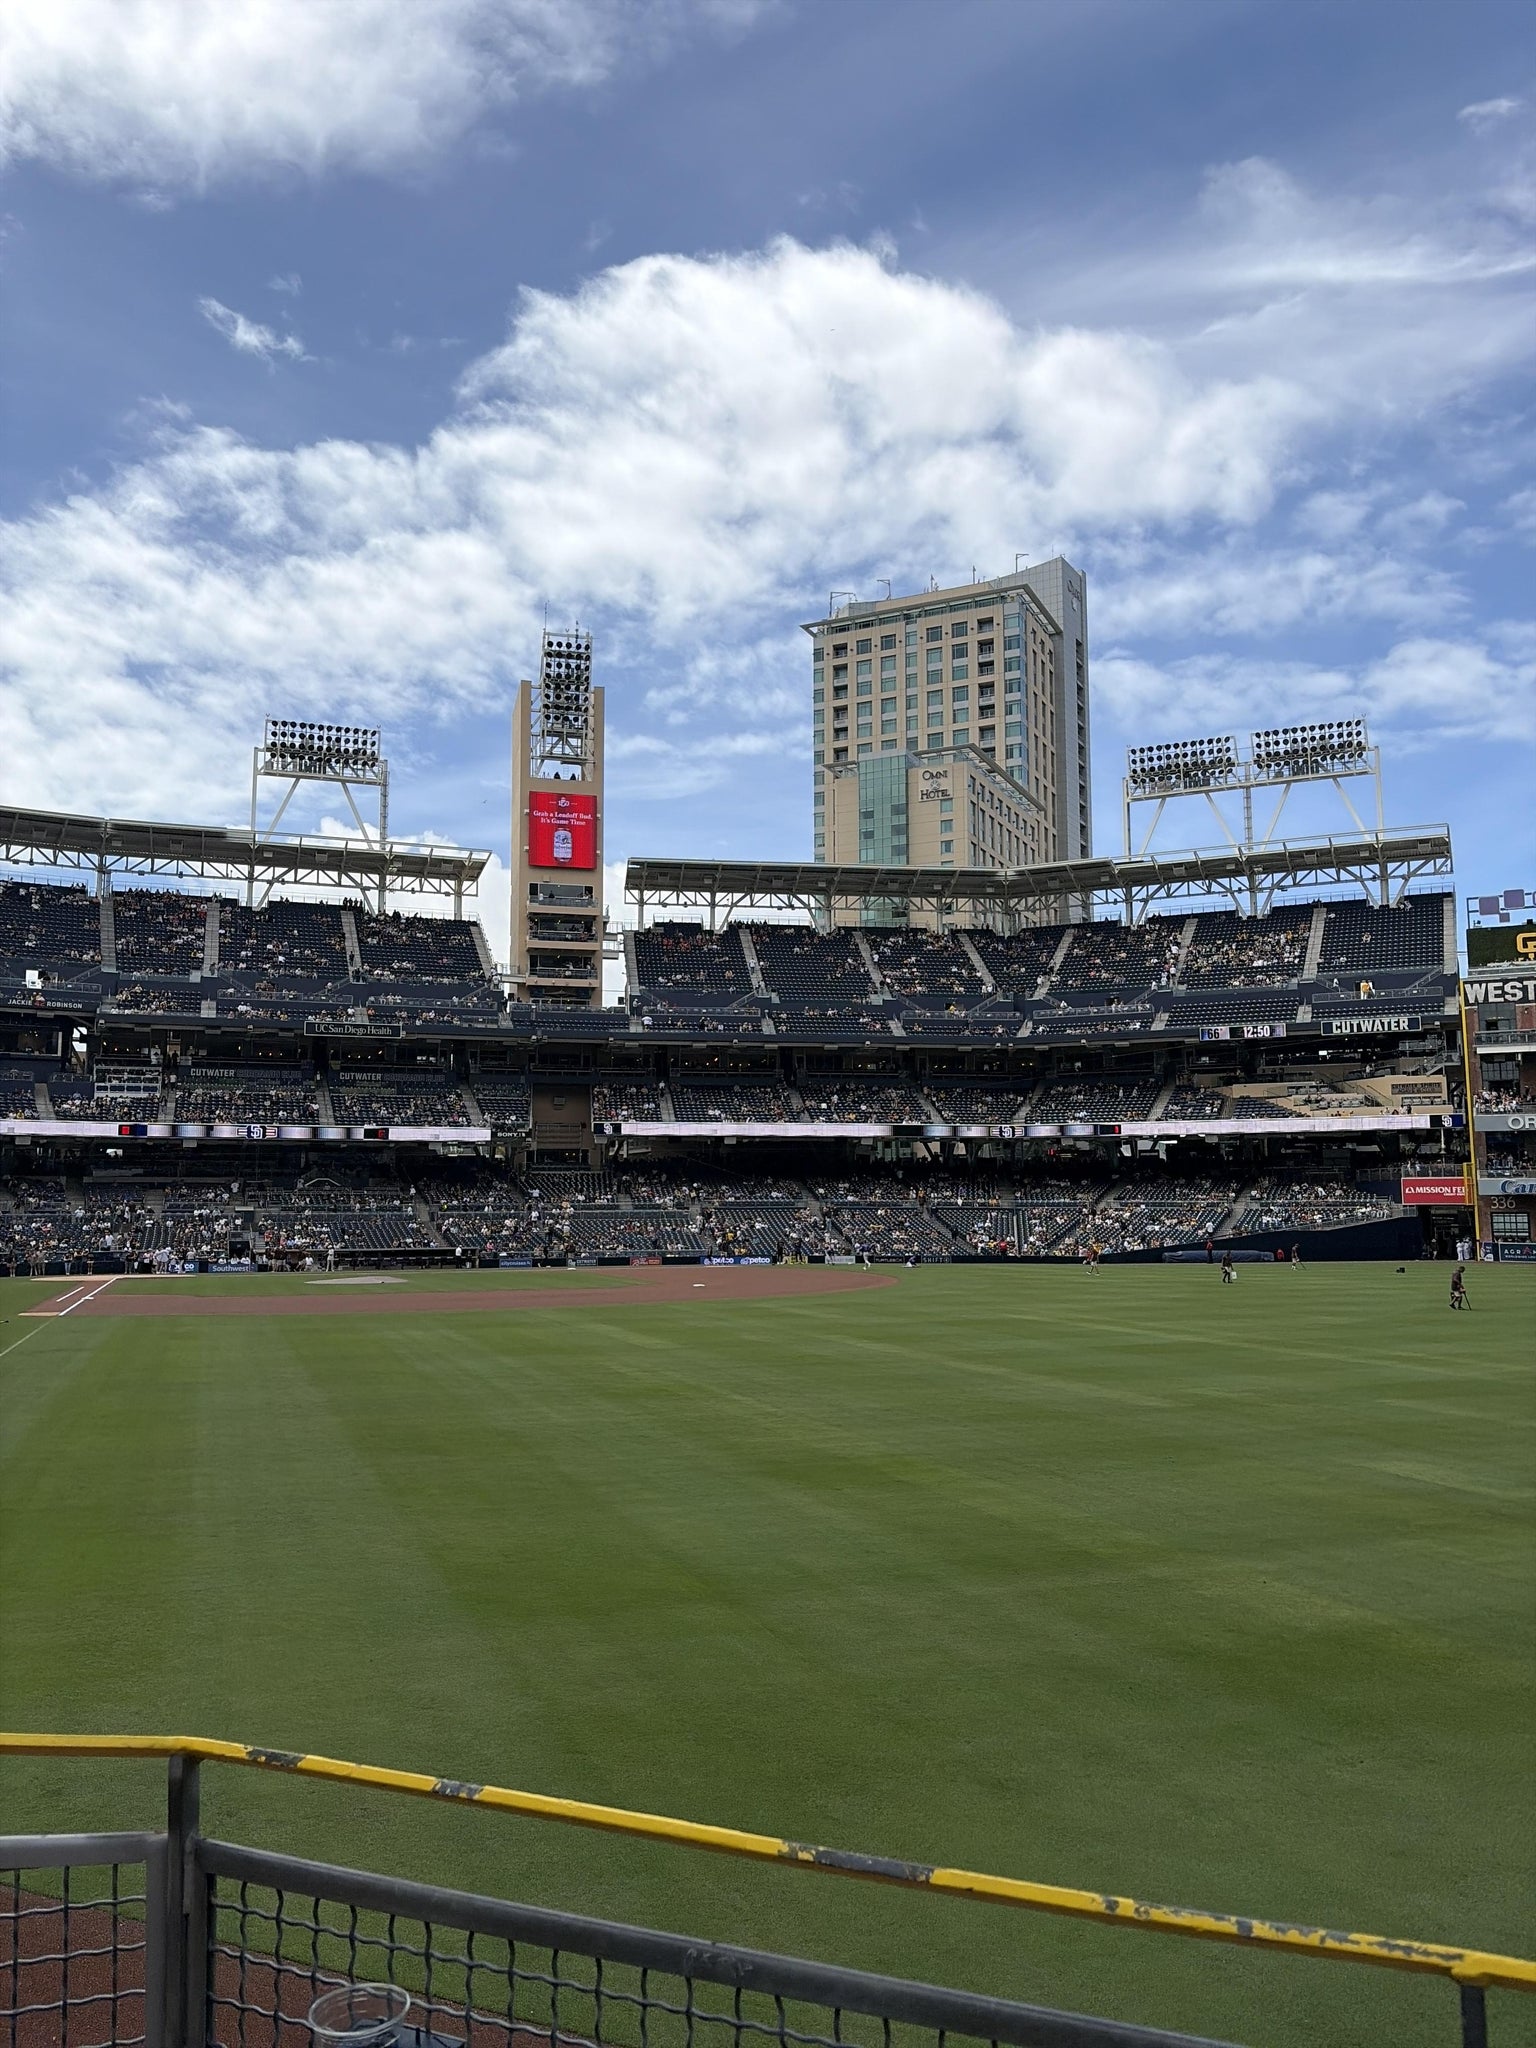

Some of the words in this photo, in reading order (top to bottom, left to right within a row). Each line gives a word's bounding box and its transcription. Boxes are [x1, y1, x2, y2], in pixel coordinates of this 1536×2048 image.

[922, 770, 948, 781] OMNI
[920, 788, 951, 800] HOTEL
[555, 811, 578, 819] Leadoff
[1464, 980, 1536, 1004] WEST
[46, 1001, 83, 1009] ROBINSON
[315, 1023, 328, 1033] UC
[328, 1023, 344, 1033] San
[344, 1024, 367, 1036] Diego
[367, 1026, 392, 1035] Health
[1332, 1017, 1409, 1034] CUTWATER
[1243, 1025, 1271, 1038] 12:50
[190, 1068, 235, 1077] CUTWATER
[339, 1072, 382, 1081] CUTWATER
[1416, 1186, 1451, 1194] MISSION
[1490, 1196, 1516, 1209] 336
[749, 1256, 771, 1265] petco
